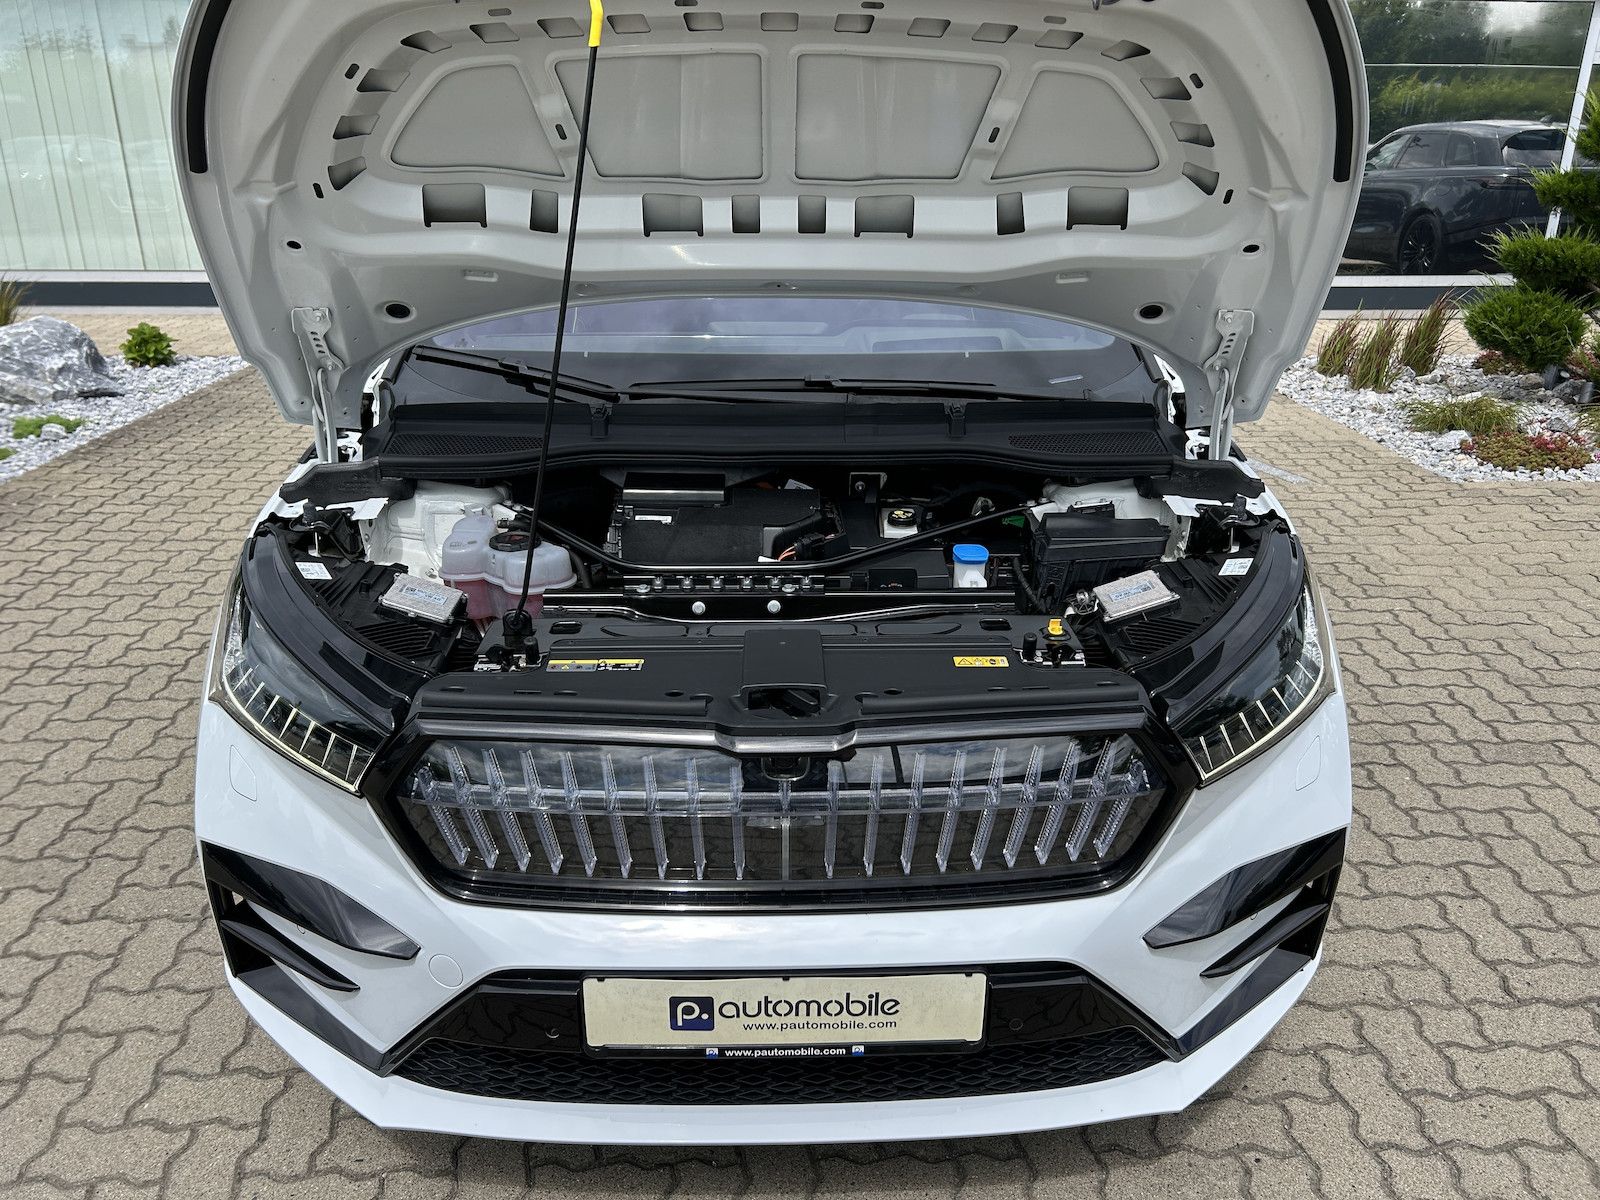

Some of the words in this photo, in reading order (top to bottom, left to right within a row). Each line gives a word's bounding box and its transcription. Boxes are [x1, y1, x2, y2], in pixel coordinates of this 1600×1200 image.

[718, 992, 901, 1018] automobile
[743, 1021, 897, 1032] www.pautomobile.com
[724, 1047, 846, 1058] www.pautomobile.com
